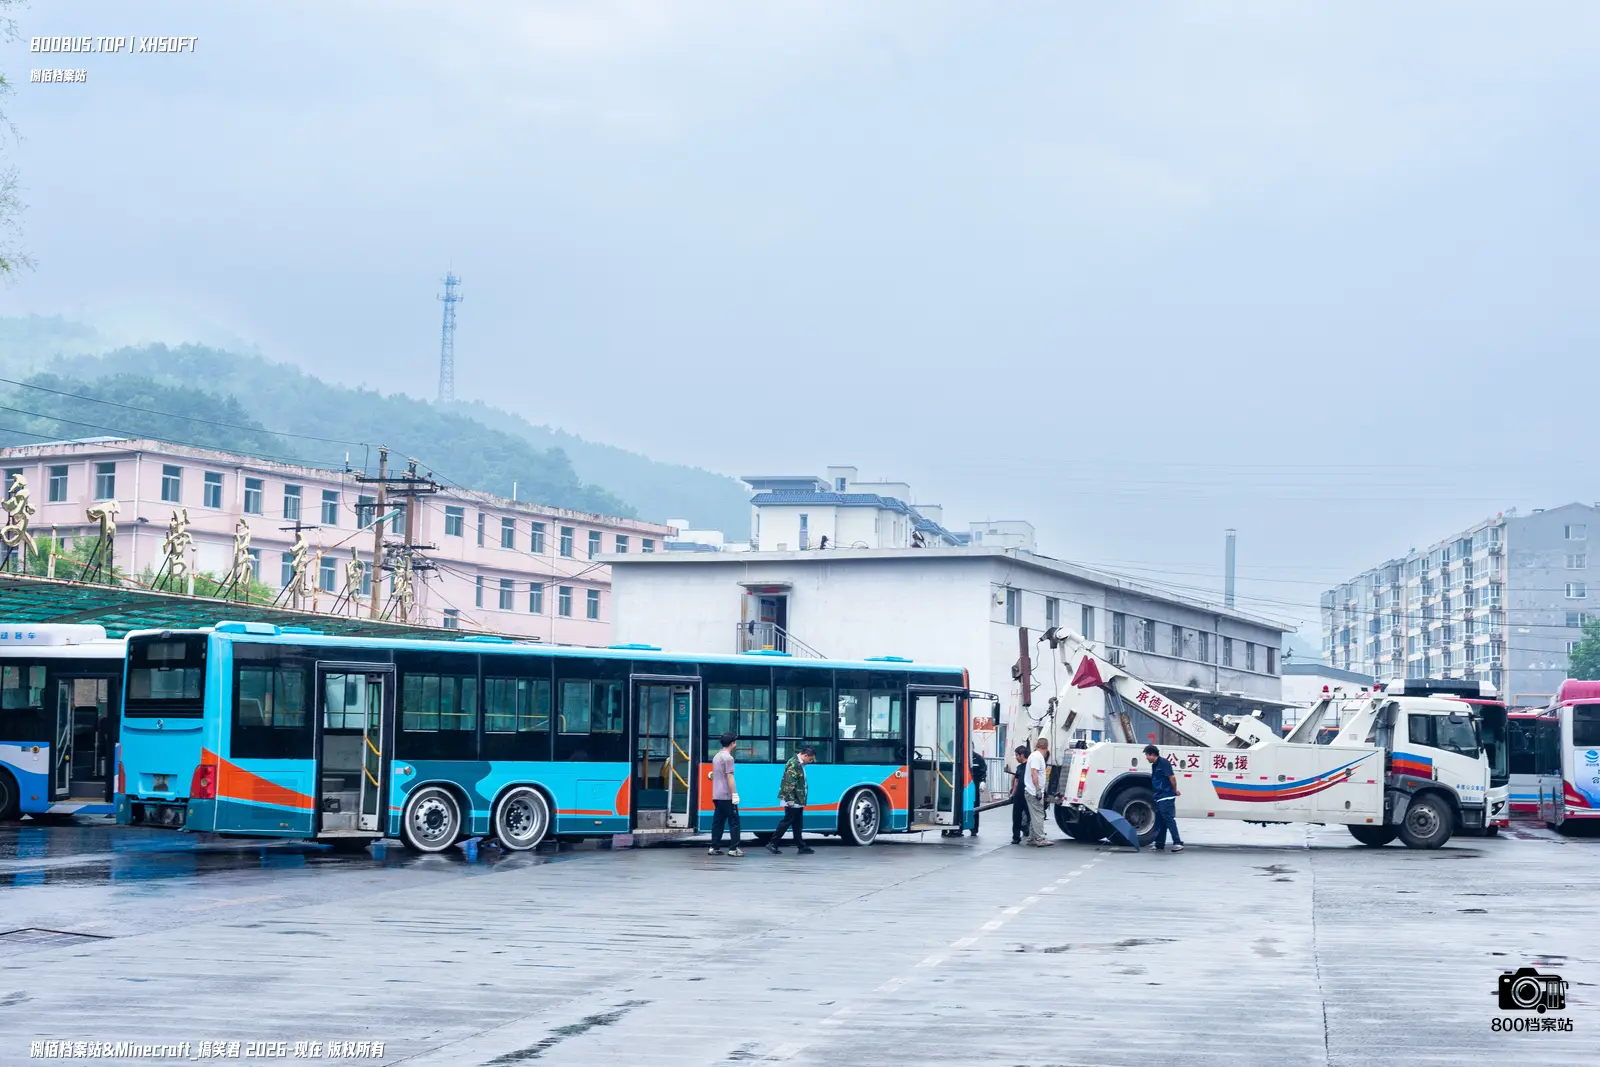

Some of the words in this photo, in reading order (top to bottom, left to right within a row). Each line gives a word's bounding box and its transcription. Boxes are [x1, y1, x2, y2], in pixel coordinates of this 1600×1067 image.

[1136, 688, 1187, 726] 承德公交
[1165, 753, 1248, 770] 公交救援
